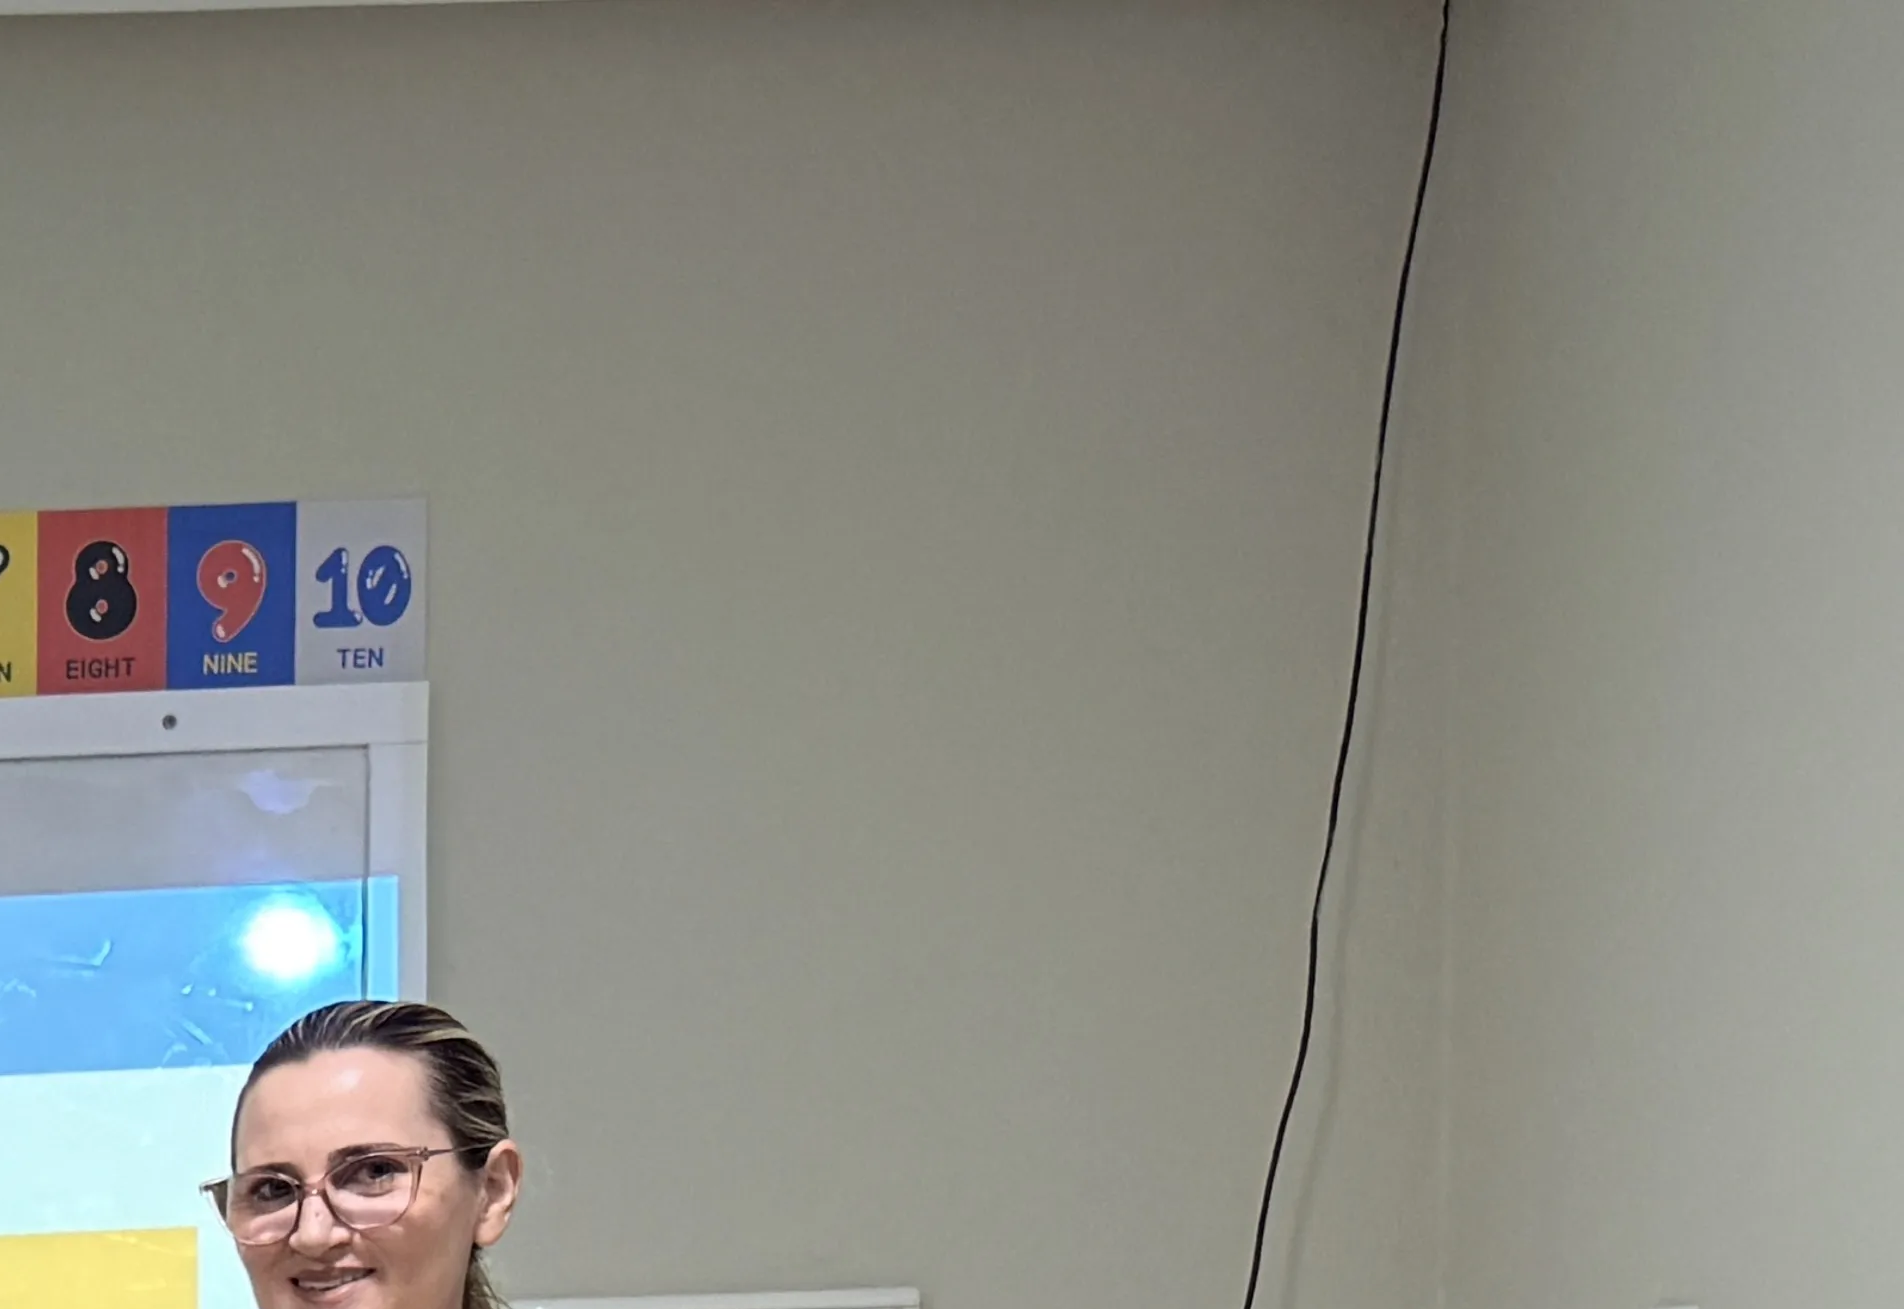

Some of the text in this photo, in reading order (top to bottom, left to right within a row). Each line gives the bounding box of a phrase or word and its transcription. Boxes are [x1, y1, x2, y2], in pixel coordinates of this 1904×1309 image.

[65, 540, 138, 641] 8
[196, 540, 267, 643] 9
[313, 545, 411, 628] 10
[65, 657, 135, 680] EIGHT
[202, 652, 258, 675] NINE
[336, 647, 384, 669] TEN
